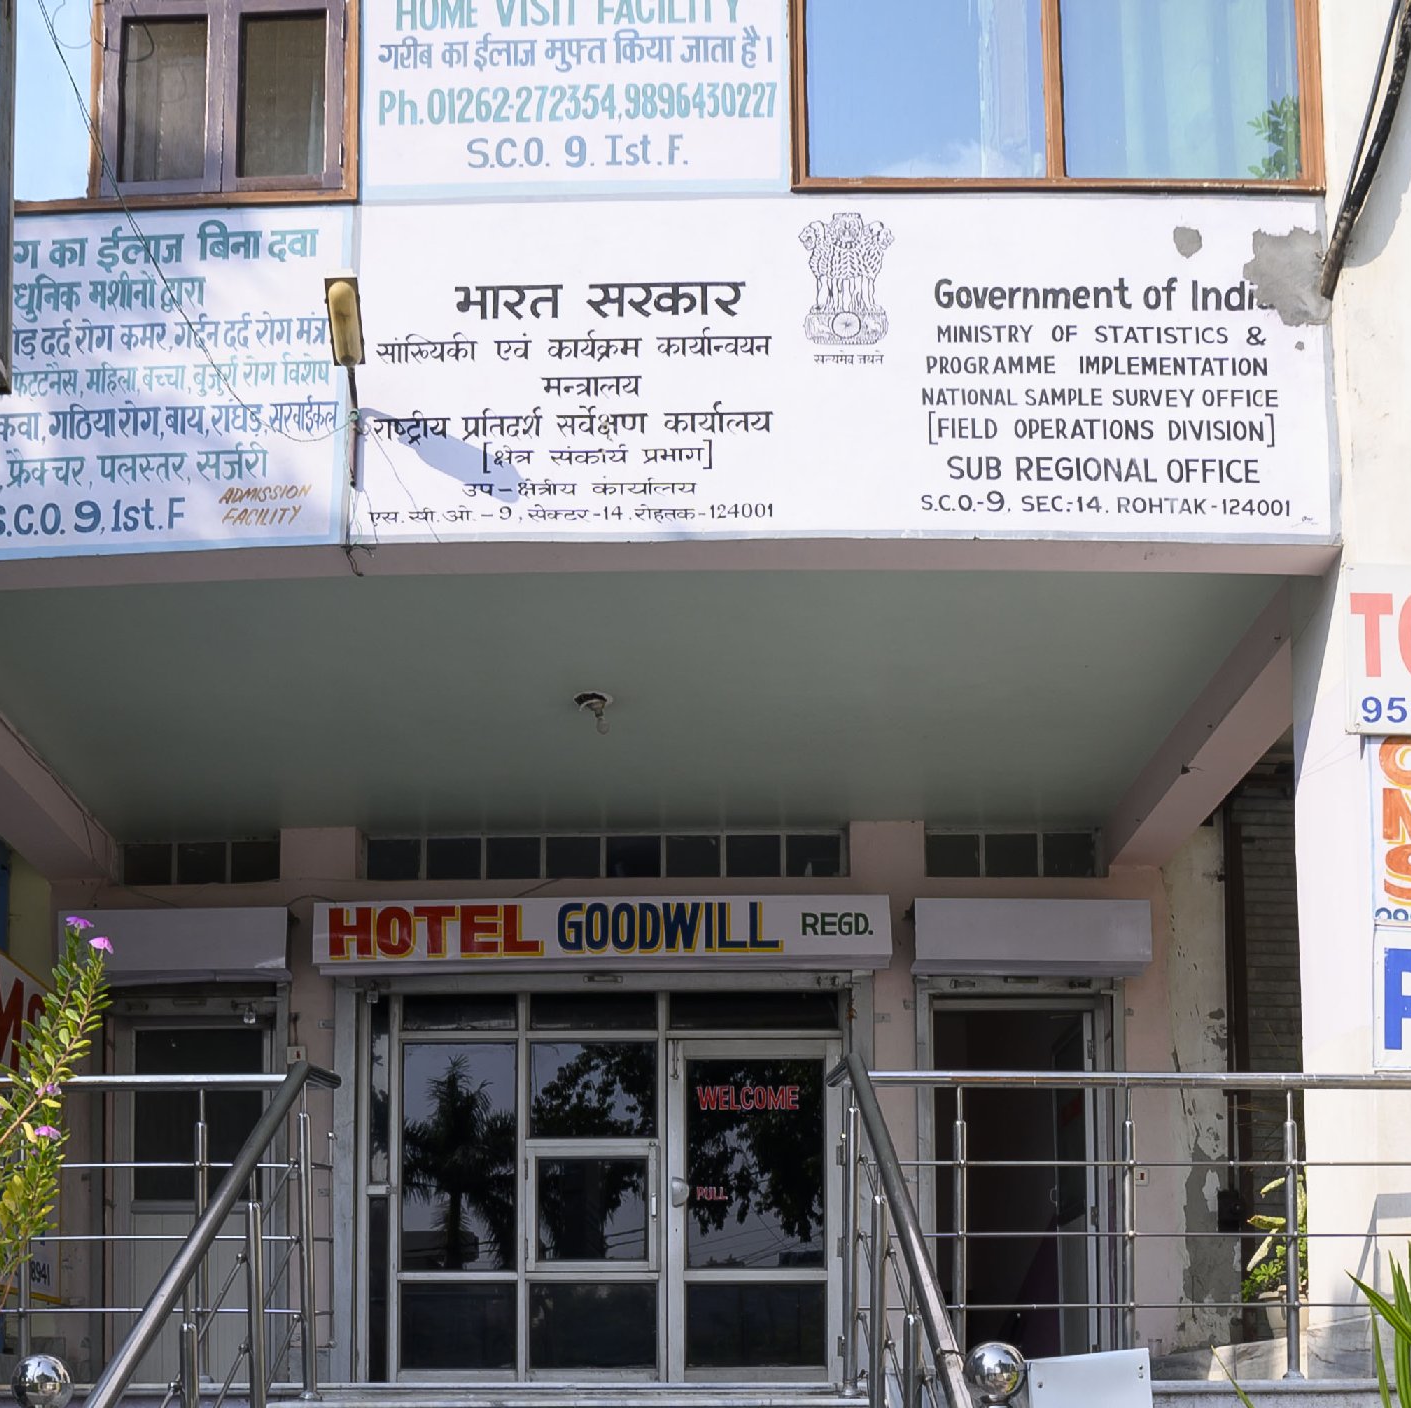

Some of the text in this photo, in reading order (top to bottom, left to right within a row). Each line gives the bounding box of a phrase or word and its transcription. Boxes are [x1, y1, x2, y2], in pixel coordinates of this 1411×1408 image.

[395, 0, 478, 31] HOME
[379, 36, 433, 71] गरीब
[441, 41, 468, 68] का
[474, 32, 536, 72] ईलाज
[544, 37, 607, 73] मुफ्त
[613, 29, 675, 64] किया
[680, 36, 735, 64] जाता
[49, 237, 88, 269] का
[97, 226, 185, 273] ईलाज
[197, 219, 262, 262] बिना
[268, 228, 319, 263] दवा
[455, 280, 746, 320] भारत सरकार
[934, 276, 1276, 312] Government of Indi
[75, 318, 115, 352] रोग
[256, 311, 291, 347] रोग
[494, 333, 532, 360] एवं
[548, 329, 642, 362] कार्यक्रम
[656, 326, 772, 357] कार्यान्वयन
[937, 324, 1267, 346] MINISTRY OF STATISTICS &
[926, 356, 1268, 377] PROGRAMME IMPLEMENTATION
[540, 375, 642, 397] मन्त्रालय
[921, 387, 1279, 408] NATIONAL SAMPLE SURVEY OFFICE
[374, 410, 451, 445] राष्ट्रीय
[462, 406, 543, 441] प्रतिदर्श
[664, 400, 773, 434] कार्यालय
[1014, 419, 1154, 442] OPERATIONS
[946, 455, 1261, 484] SUB REGIONAL OFFICE
[218, 484, 312, 504] ADMISSION
[221, 505, 302, 527] FACILITY
[328, 901, 874, 961] HOTEL GOODWILL REGD.
[696, 1085, 800, 1111] WELCOME
[696, 1186, 728, 1201] PULL
